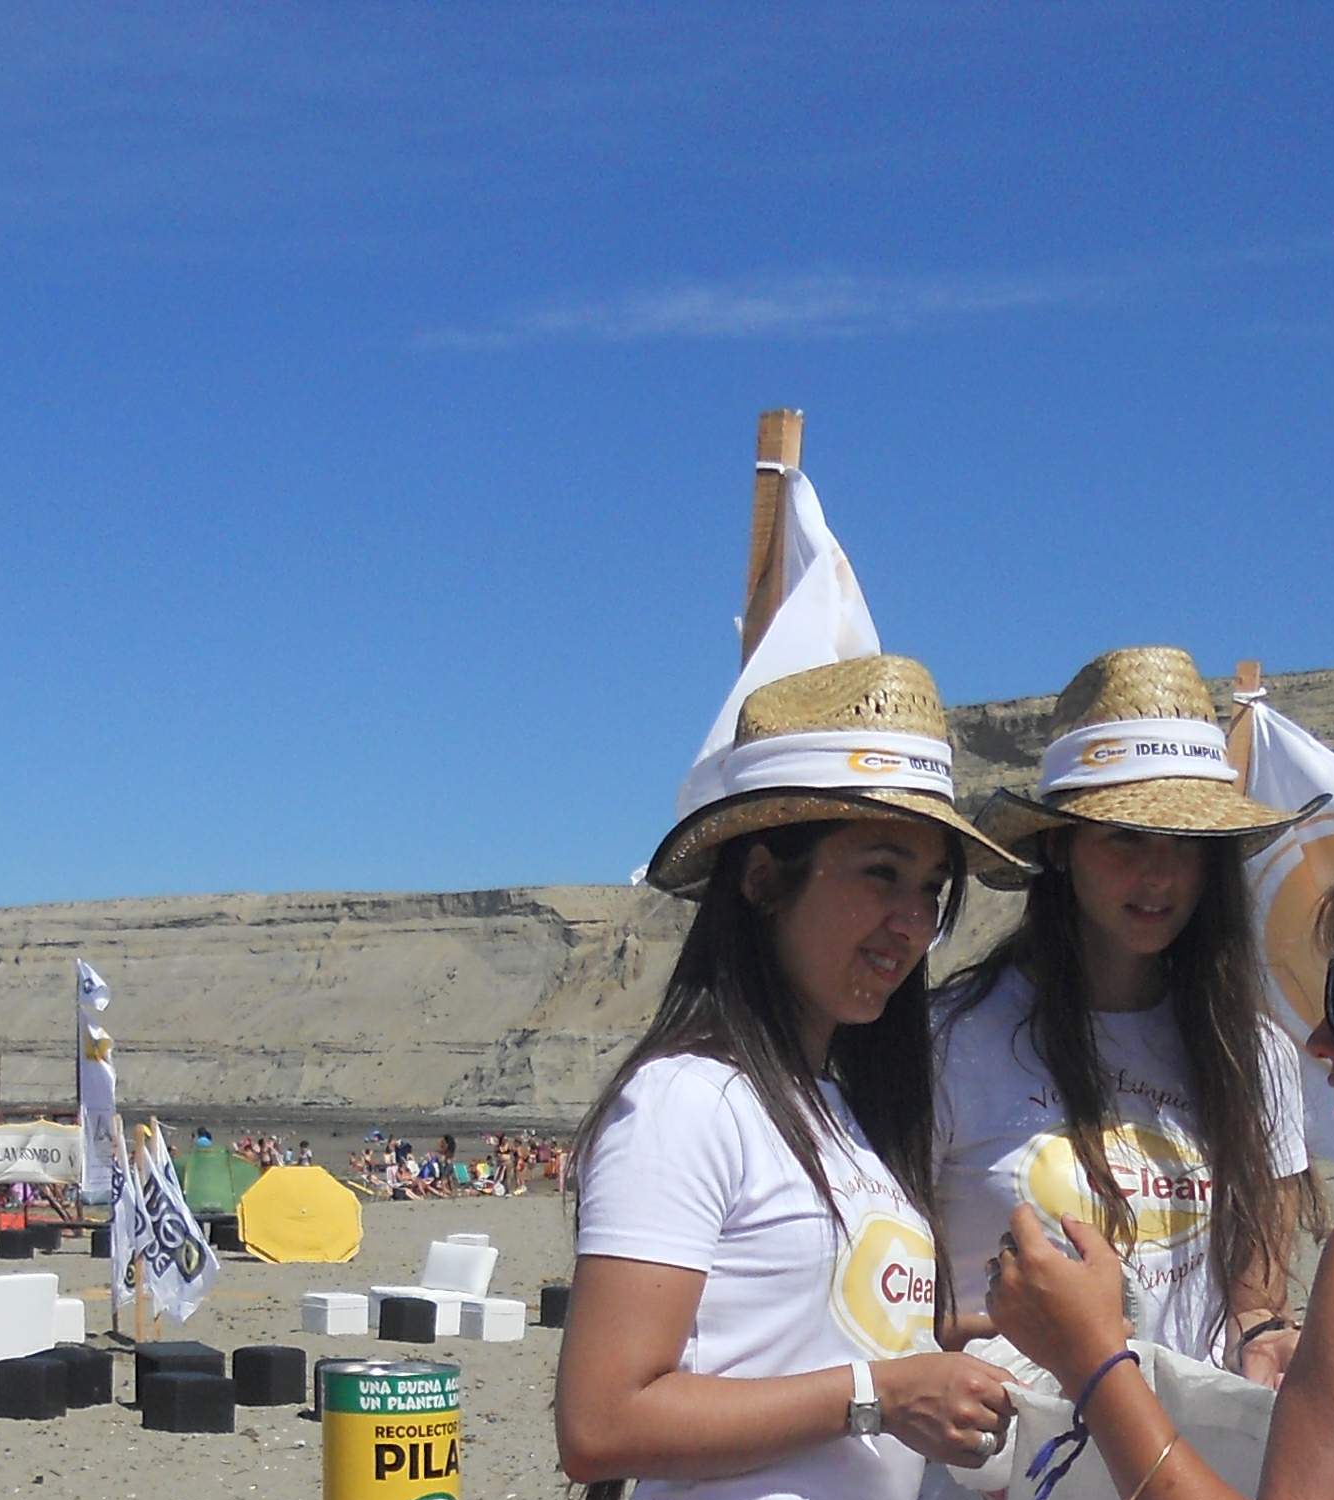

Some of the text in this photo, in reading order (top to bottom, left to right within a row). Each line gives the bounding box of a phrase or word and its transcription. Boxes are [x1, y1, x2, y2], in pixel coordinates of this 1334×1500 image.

[1135, 743, 1179, 756] IDEAS
[881, 1262, 934, 1305] Clea
[359, 1380, 392, 1395] UNA
[397, 1379, 441, 1395] BUENA
[359, 1396, 381, 1410] UN
[387, 1394, 446, 1410] PLANETA
